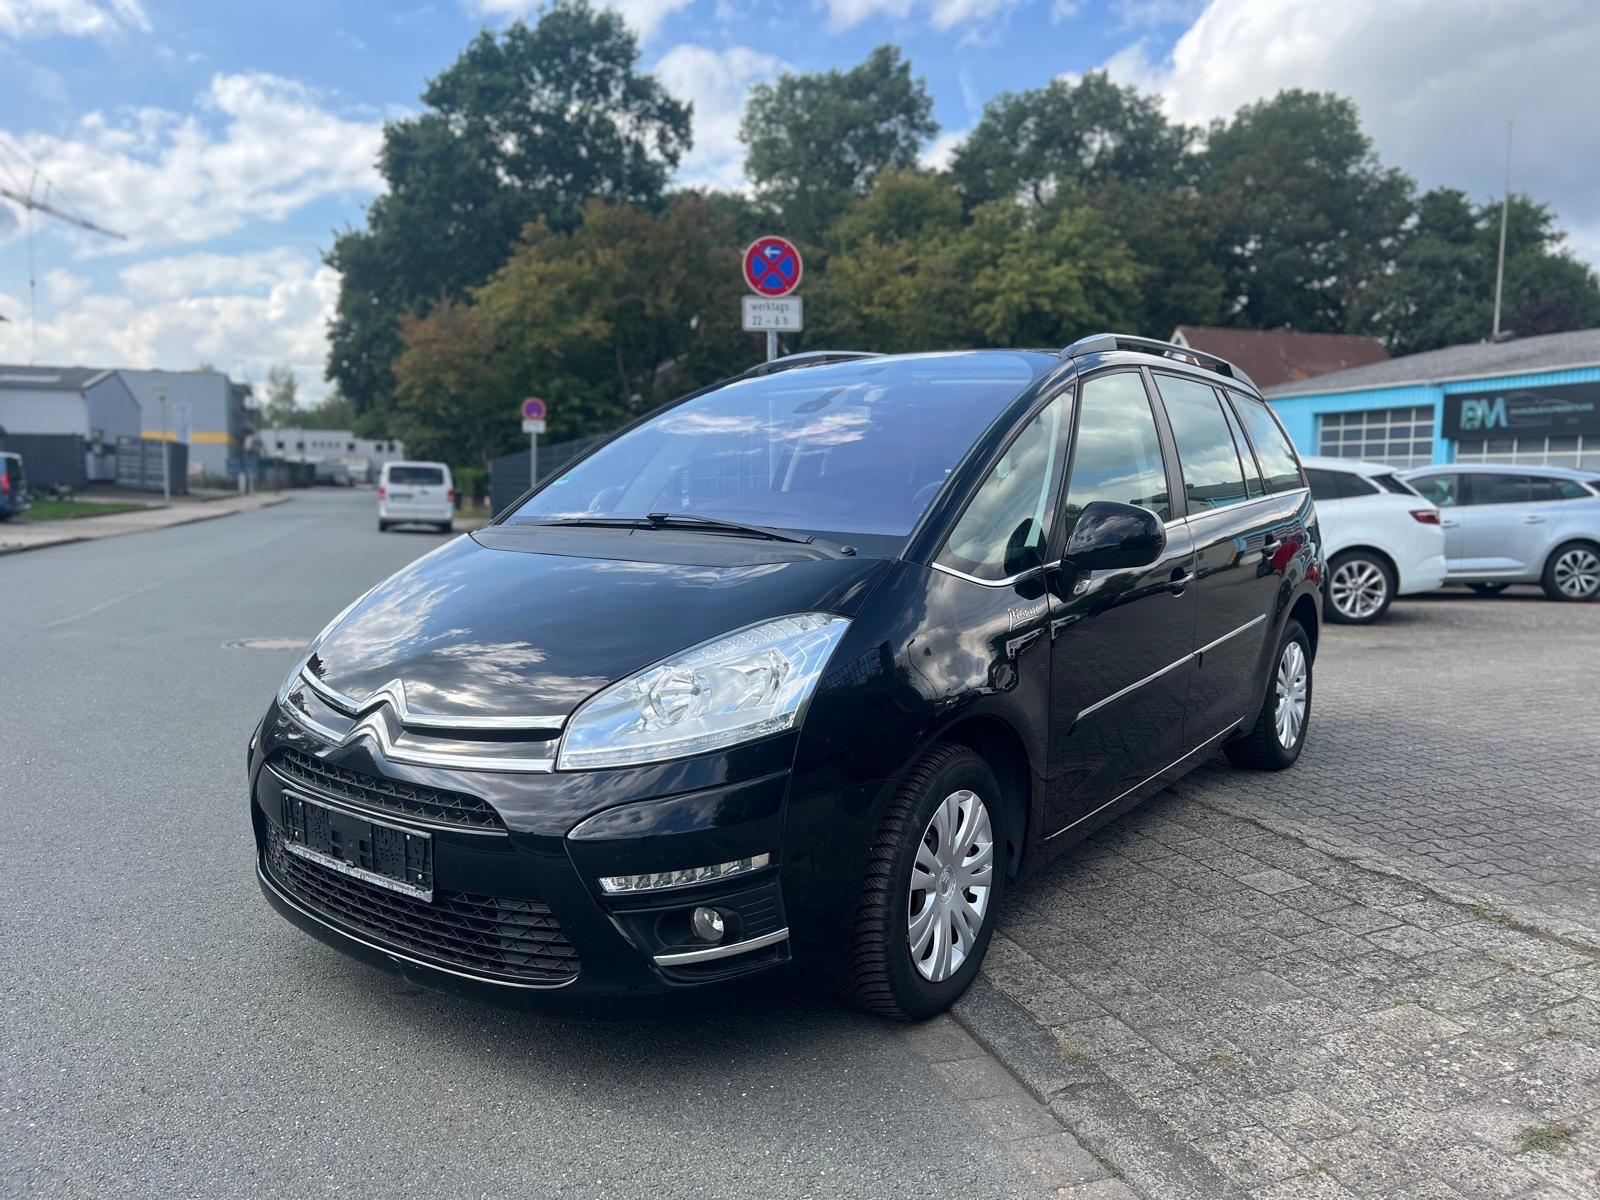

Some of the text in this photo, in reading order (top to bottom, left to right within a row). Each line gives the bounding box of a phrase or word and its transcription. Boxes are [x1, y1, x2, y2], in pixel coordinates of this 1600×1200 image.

[751, 302, 789, 314] werktags
[752, 315, 762, 326] 22
[783, 315, 789, 326] h
